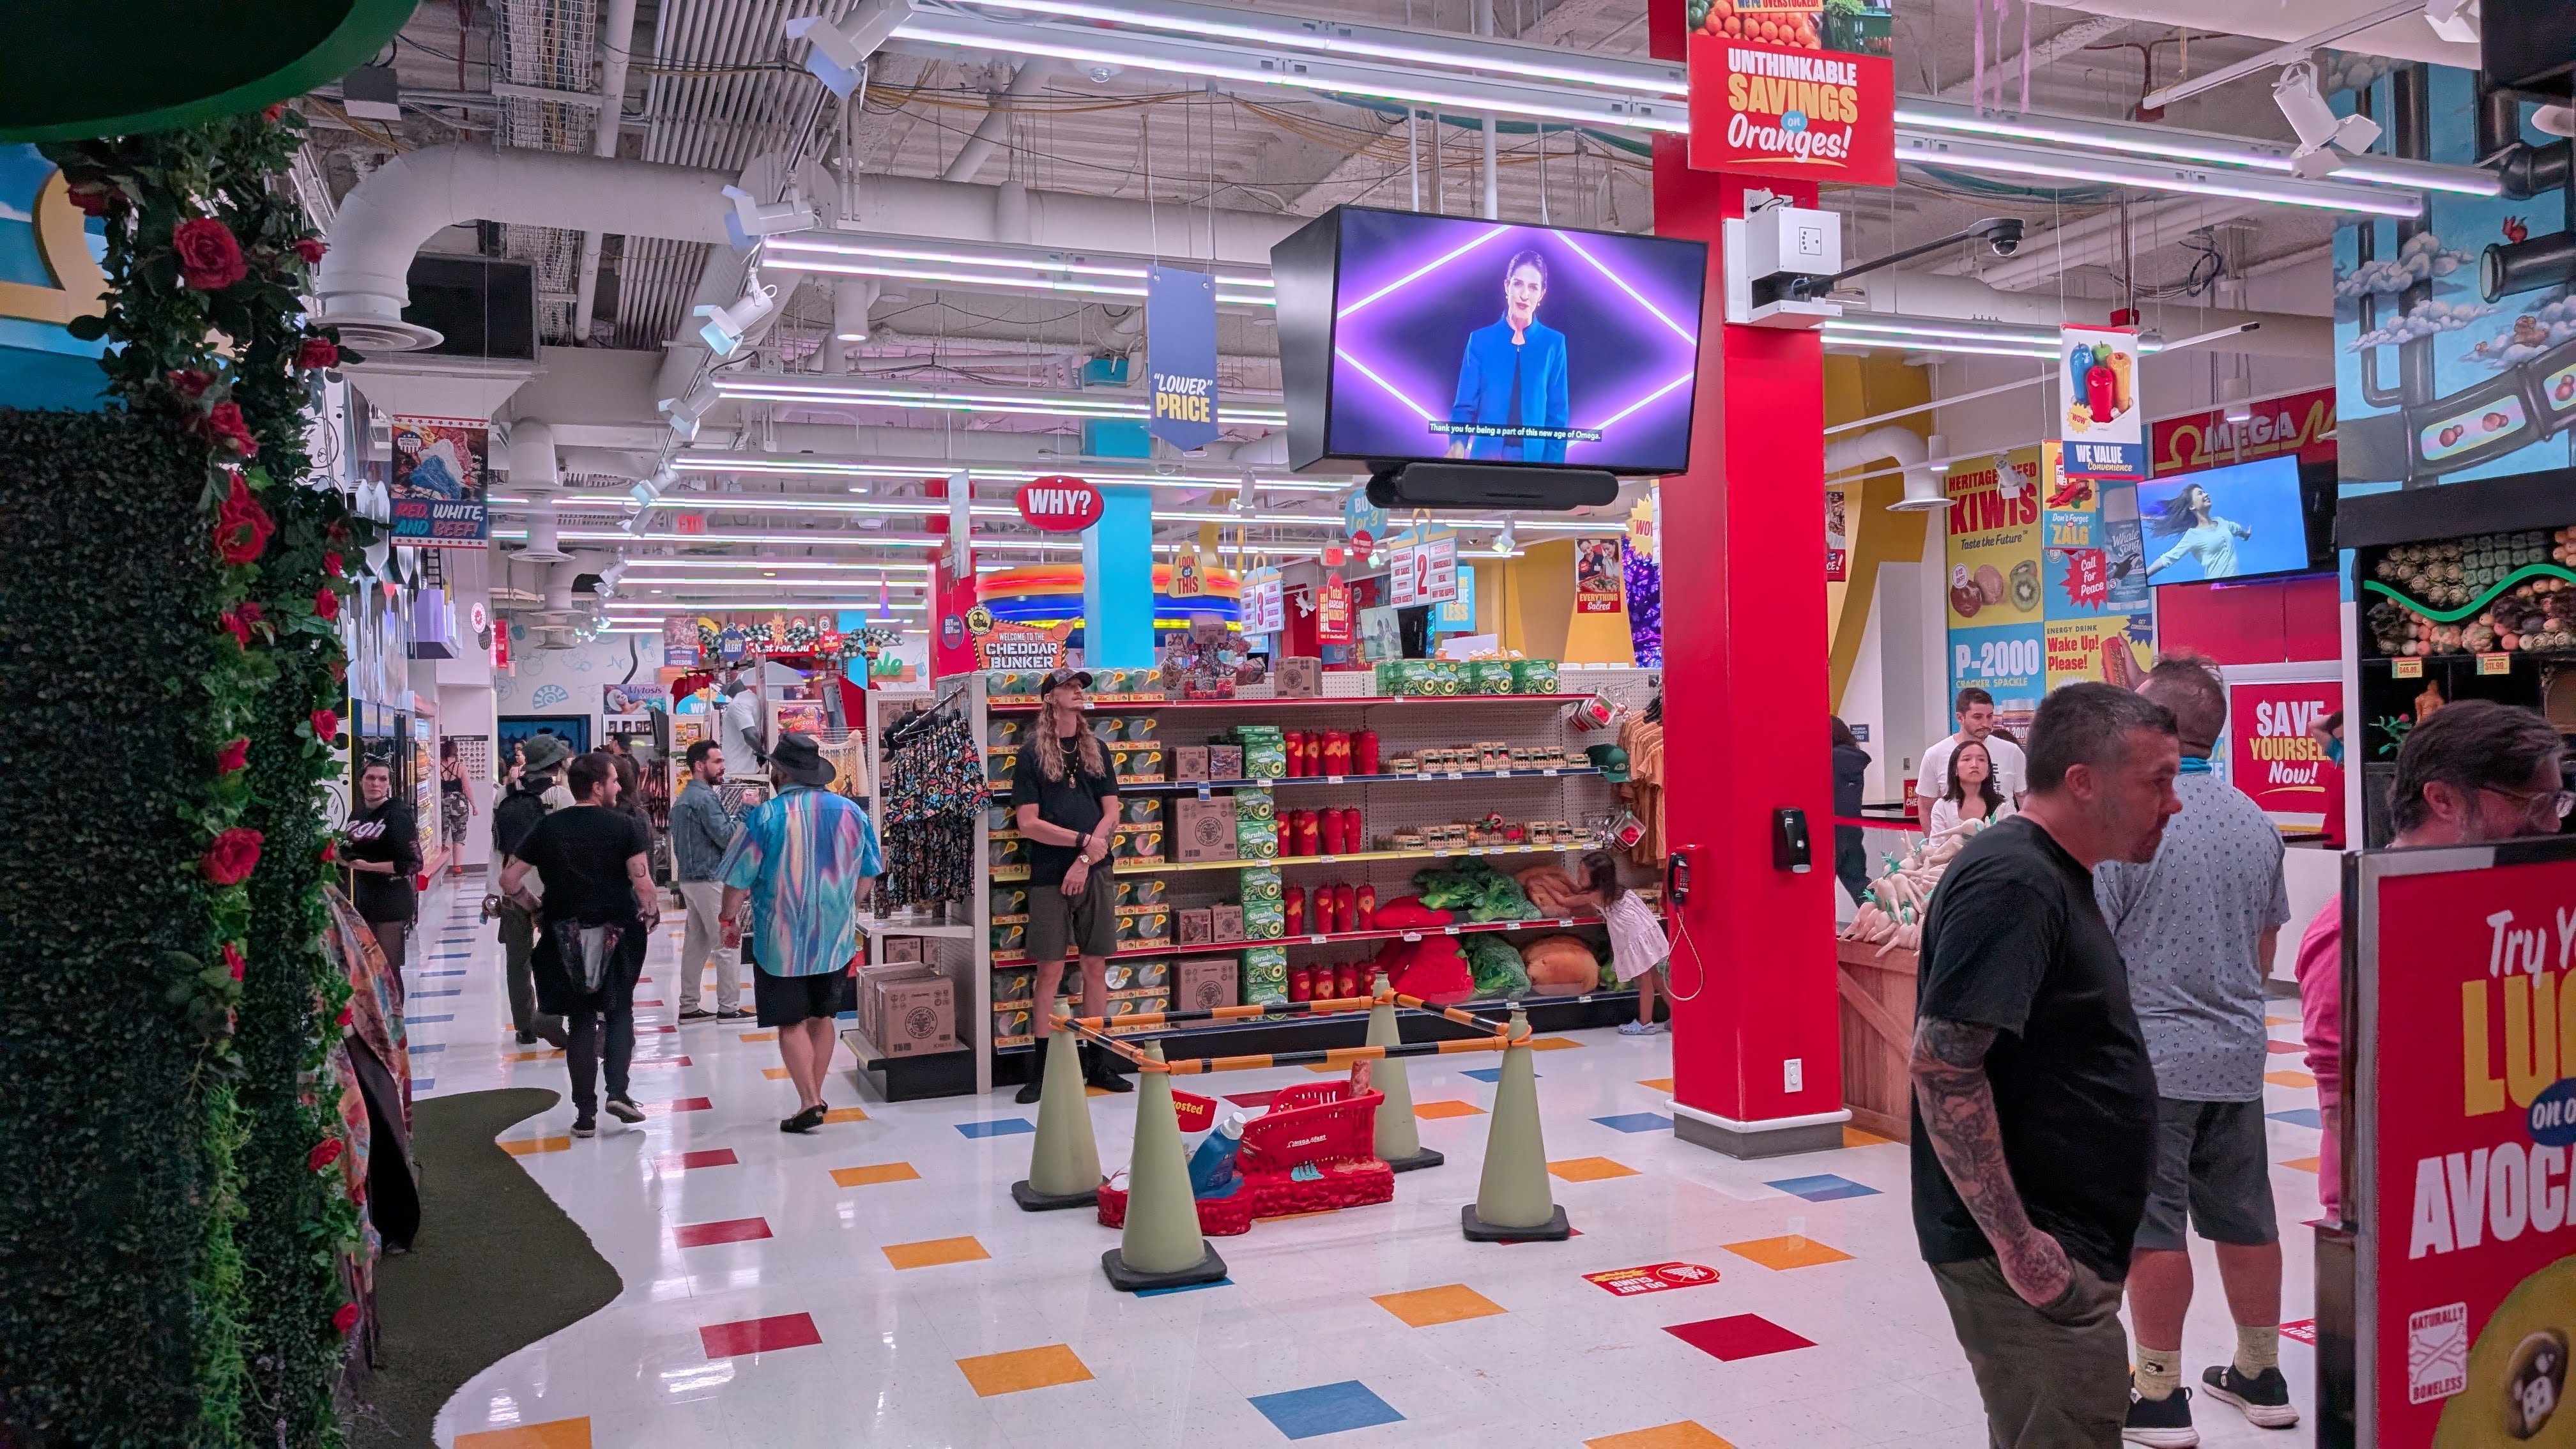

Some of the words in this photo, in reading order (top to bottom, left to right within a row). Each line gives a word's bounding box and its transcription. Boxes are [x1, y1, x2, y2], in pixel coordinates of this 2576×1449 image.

[1728, 47, 1857, 87] UNTHINKABLE
[1728, 73, 1859, 124] SAVINGS
[1788, 117, 1801, 127] on
[1727, 112, 1852, 164] Oranges!
[1156, 392, 1211, 423] PRICE
[1430, 423, 1450, 432] Thank
[1465, 425, 1475, 433] for
[1476, 425, 1495, 436] being
[1502, 427, 1516, 436] part
[1517, 427, 1525, 435] of
[1526, 428, 1538, 436] this
[1554, 431, 1566, 440] age
[1576, 431, 1601, 441] Omega.
[2076, 445, 2092, 463] WE
[2094, 445, 2123, 464] VALUE
[2088, 461, 2133, 472] Convenience
[1949, 468, 1998, 492] HERITAGE
[1027, 487, 1092, 516] WHY?
[1949, 483, 2037, 535] KIWIS
[433, 504, 484, 521] WHITE,
[2052, 513, 2069, 523] Don't
[2069, 515, 2089, 524] Forget
[395, 519, 428, 535] AND
[433, 521, 479, 537] BEEF!
[1961, 539, 1981, 550] Taste
[1982, 537, 1995, 547] the
[1996, 533, 2022, 545] Future
[2112, 530, 2139, 548] Whale
[1178, 556, 1195, 568] LOOK
[2081, 556, 2096, 571] Call
[1417, 554, 1427, 595] 2
[2083, 571, 2096, 583] for
[1177, 576, 1199, 594] THIS
[1330, 586, 1342, 599] Total
[2081, 582, 2104, 596] Peace
[1579, 594, 1618, 602] EVERYTHING
[1588, 601, 1611, 610] Sacred
[1257, 592, 1264, 626] 3
[1443, 603, 1468, 621] LESS
[999, 632, 1025, 641] WELCOME
[1026, 632, 1033, 641] TO
[1034, 632, 1045, 641] THE
[2047, 636, 2078, 653] Wake
[2080, 634, 2099, 652] Up!
[724, 643, 742, 653] ALERT
[986, 643, 1058, 655] CHEDDAR
[991, 656, 1054, 668] BUNKER
[1956, 639, 2039, 678] P-2000
[2048, 654, 2088, 671] Please!
[1405, 668, 1426, 677] Shrubs
[1482, 668, 1501, 677] Shrubs
[1527, 668, 1547, 677] Shrubs
[1251, 750, 1273, 759] Shrubs
[2249, 737, 2331, 761] YOURSEL
[2269, 761, 2319, 785] Now!
[1238, 793, 1261, 802] Shrubs
[1243, 831, 1266, 840] Shrubs
[1246, 873, 1269, 882] Shrubs
[1249, 911, 1271, 920] Shrubs
[2487, 909, 2546, 989] Try
[1251, 954, 1274, 964] Shrubs
[1252, 992, 1275, 1002] Shrubs
[2408, 1142, 2576, 1261] AVOC
[1607, 1276, 1654, 1287] CLIMB
[1616, 1284, 1647, 1294] NOT
[1647, 1282, 1668, 1290] DO
[2411, 1306, 2464, 1331] NATURALLY
[2412, 1375, 2464, 1400] BONELESS
